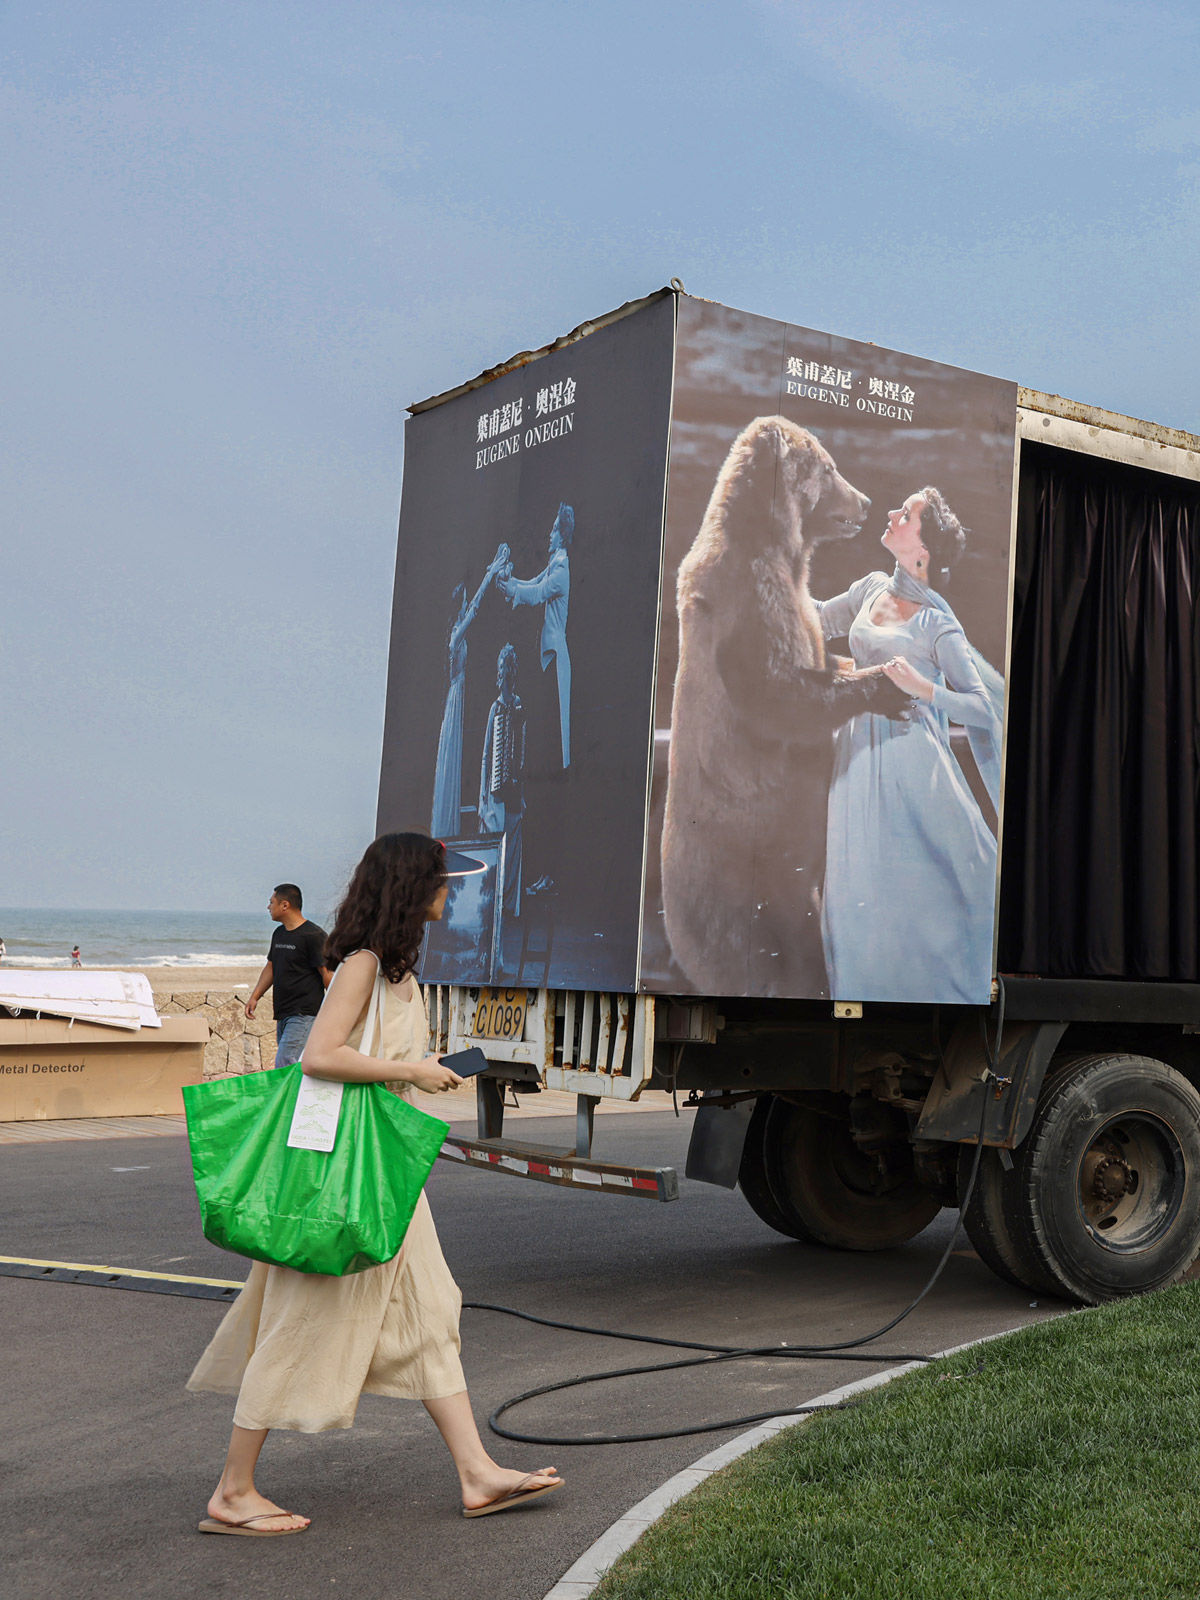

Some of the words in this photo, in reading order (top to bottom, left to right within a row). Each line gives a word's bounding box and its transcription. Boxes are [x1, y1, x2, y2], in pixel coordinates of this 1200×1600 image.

[786, 381, 850, 408] EUGENE
[856, 398, 914, 423] ONEGIN
[475, 434, 521, 470] EUGENE
[525, 413, 575, 448] ONEGIN
[476, 1004, 522, 1036] C1089
[32, 1063, 86, 1074] Detector
